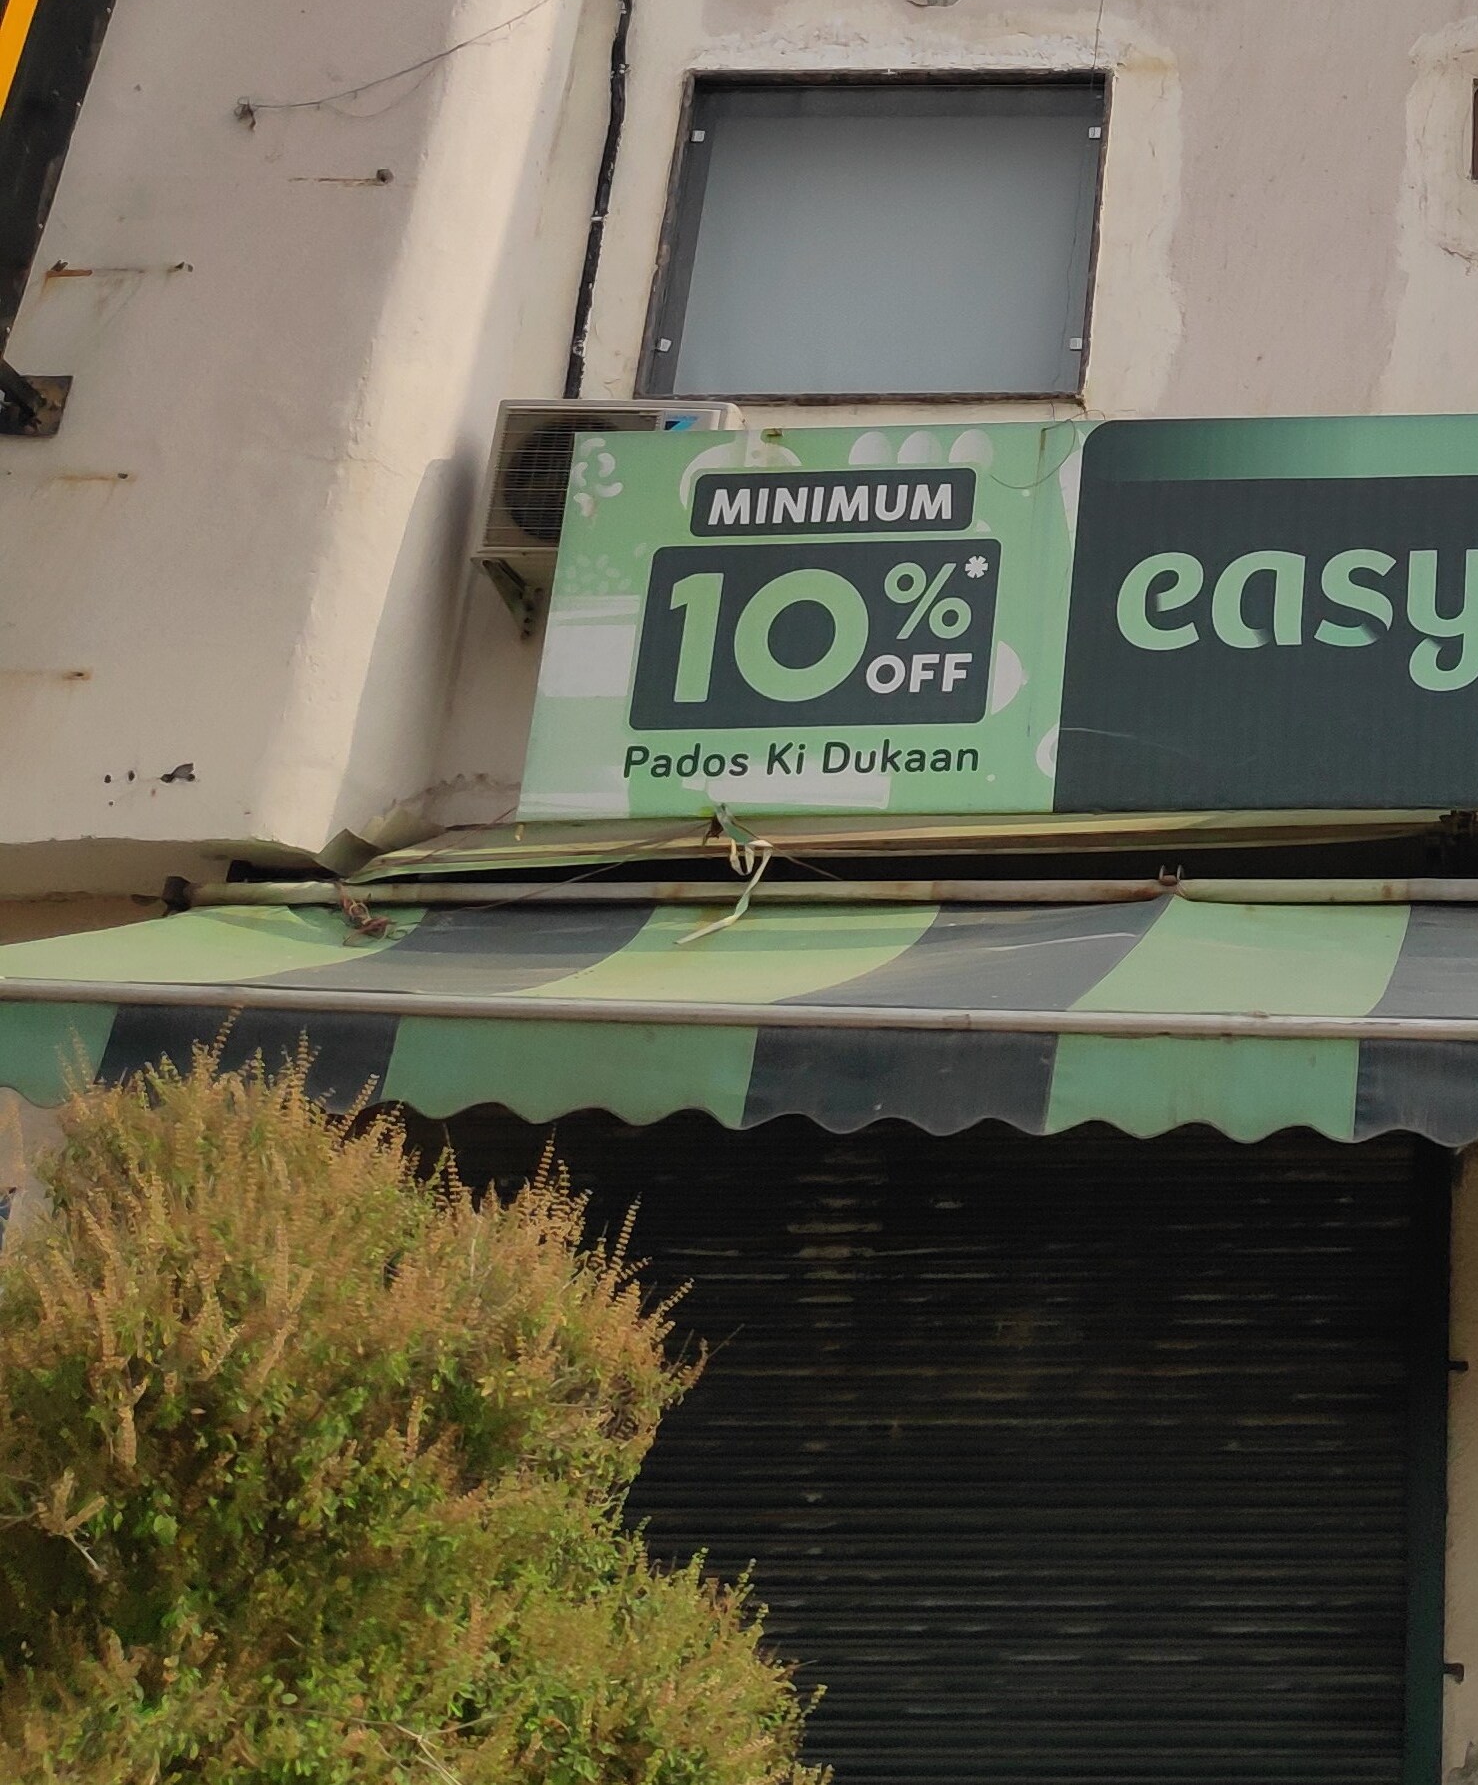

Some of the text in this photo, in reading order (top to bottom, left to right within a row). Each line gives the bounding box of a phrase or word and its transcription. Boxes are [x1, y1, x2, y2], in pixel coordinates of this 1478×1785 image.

[707, 483, 953, 526] MINIMUM
[865, 652, 973, 694] OFF
[623, 739, 980, 779] Pados Ki Dukaan
